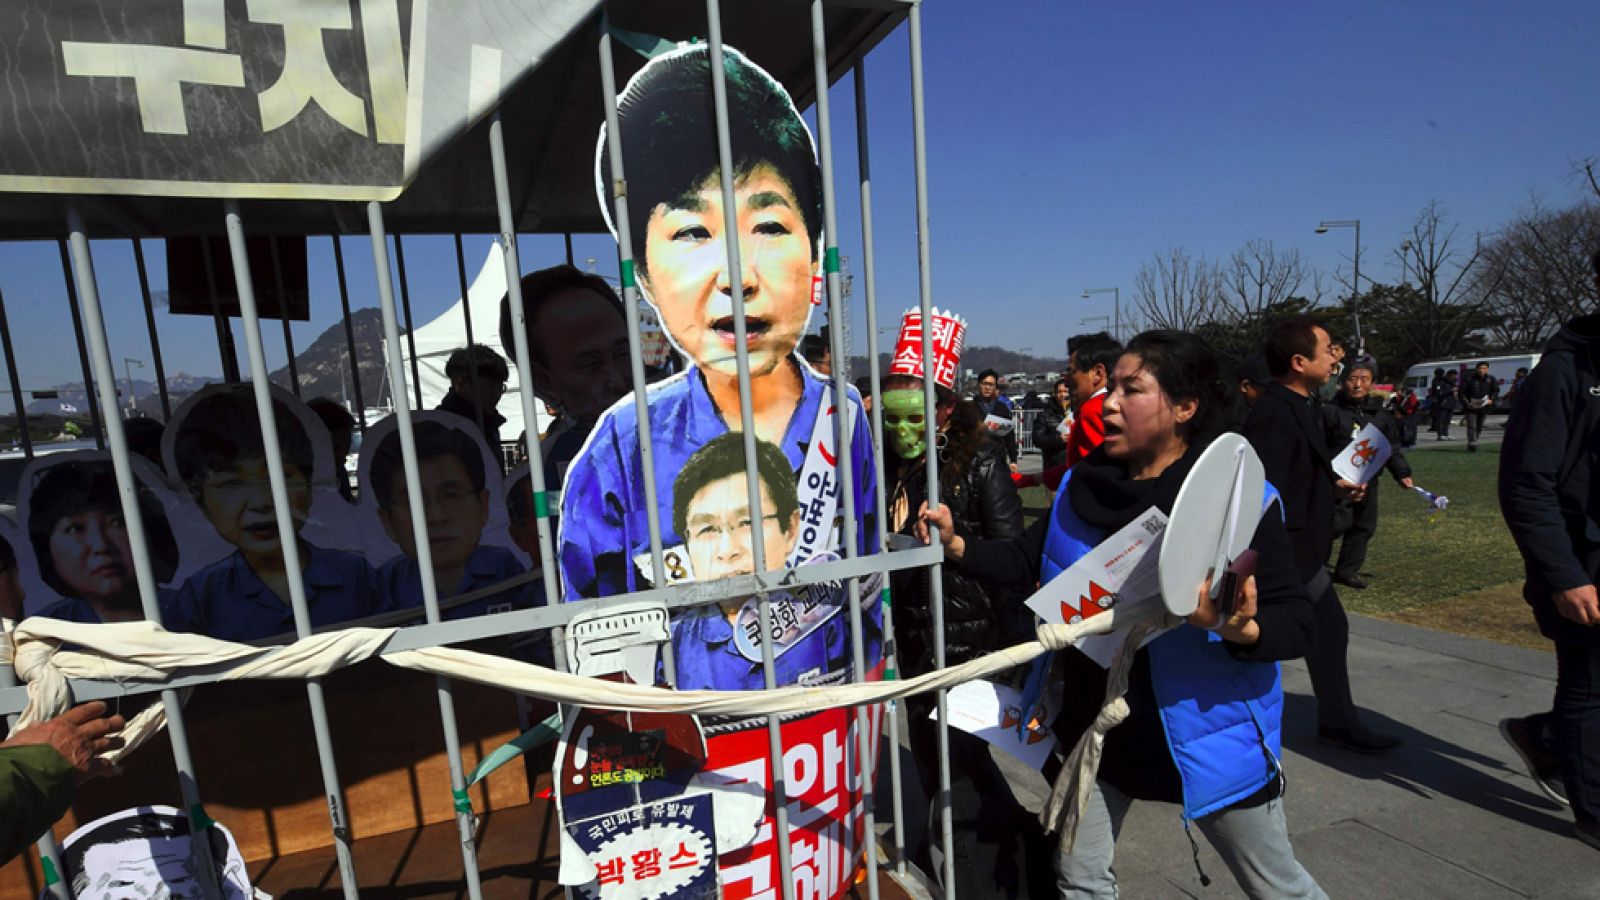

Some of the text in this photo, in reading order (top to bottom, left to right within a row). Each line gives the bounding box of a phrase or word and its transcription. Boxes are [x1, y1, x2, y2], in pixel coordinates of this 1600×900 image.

[588, 802, 696, 839] 국민피로 유발제
[594, 841, 700, 885] 박황스
